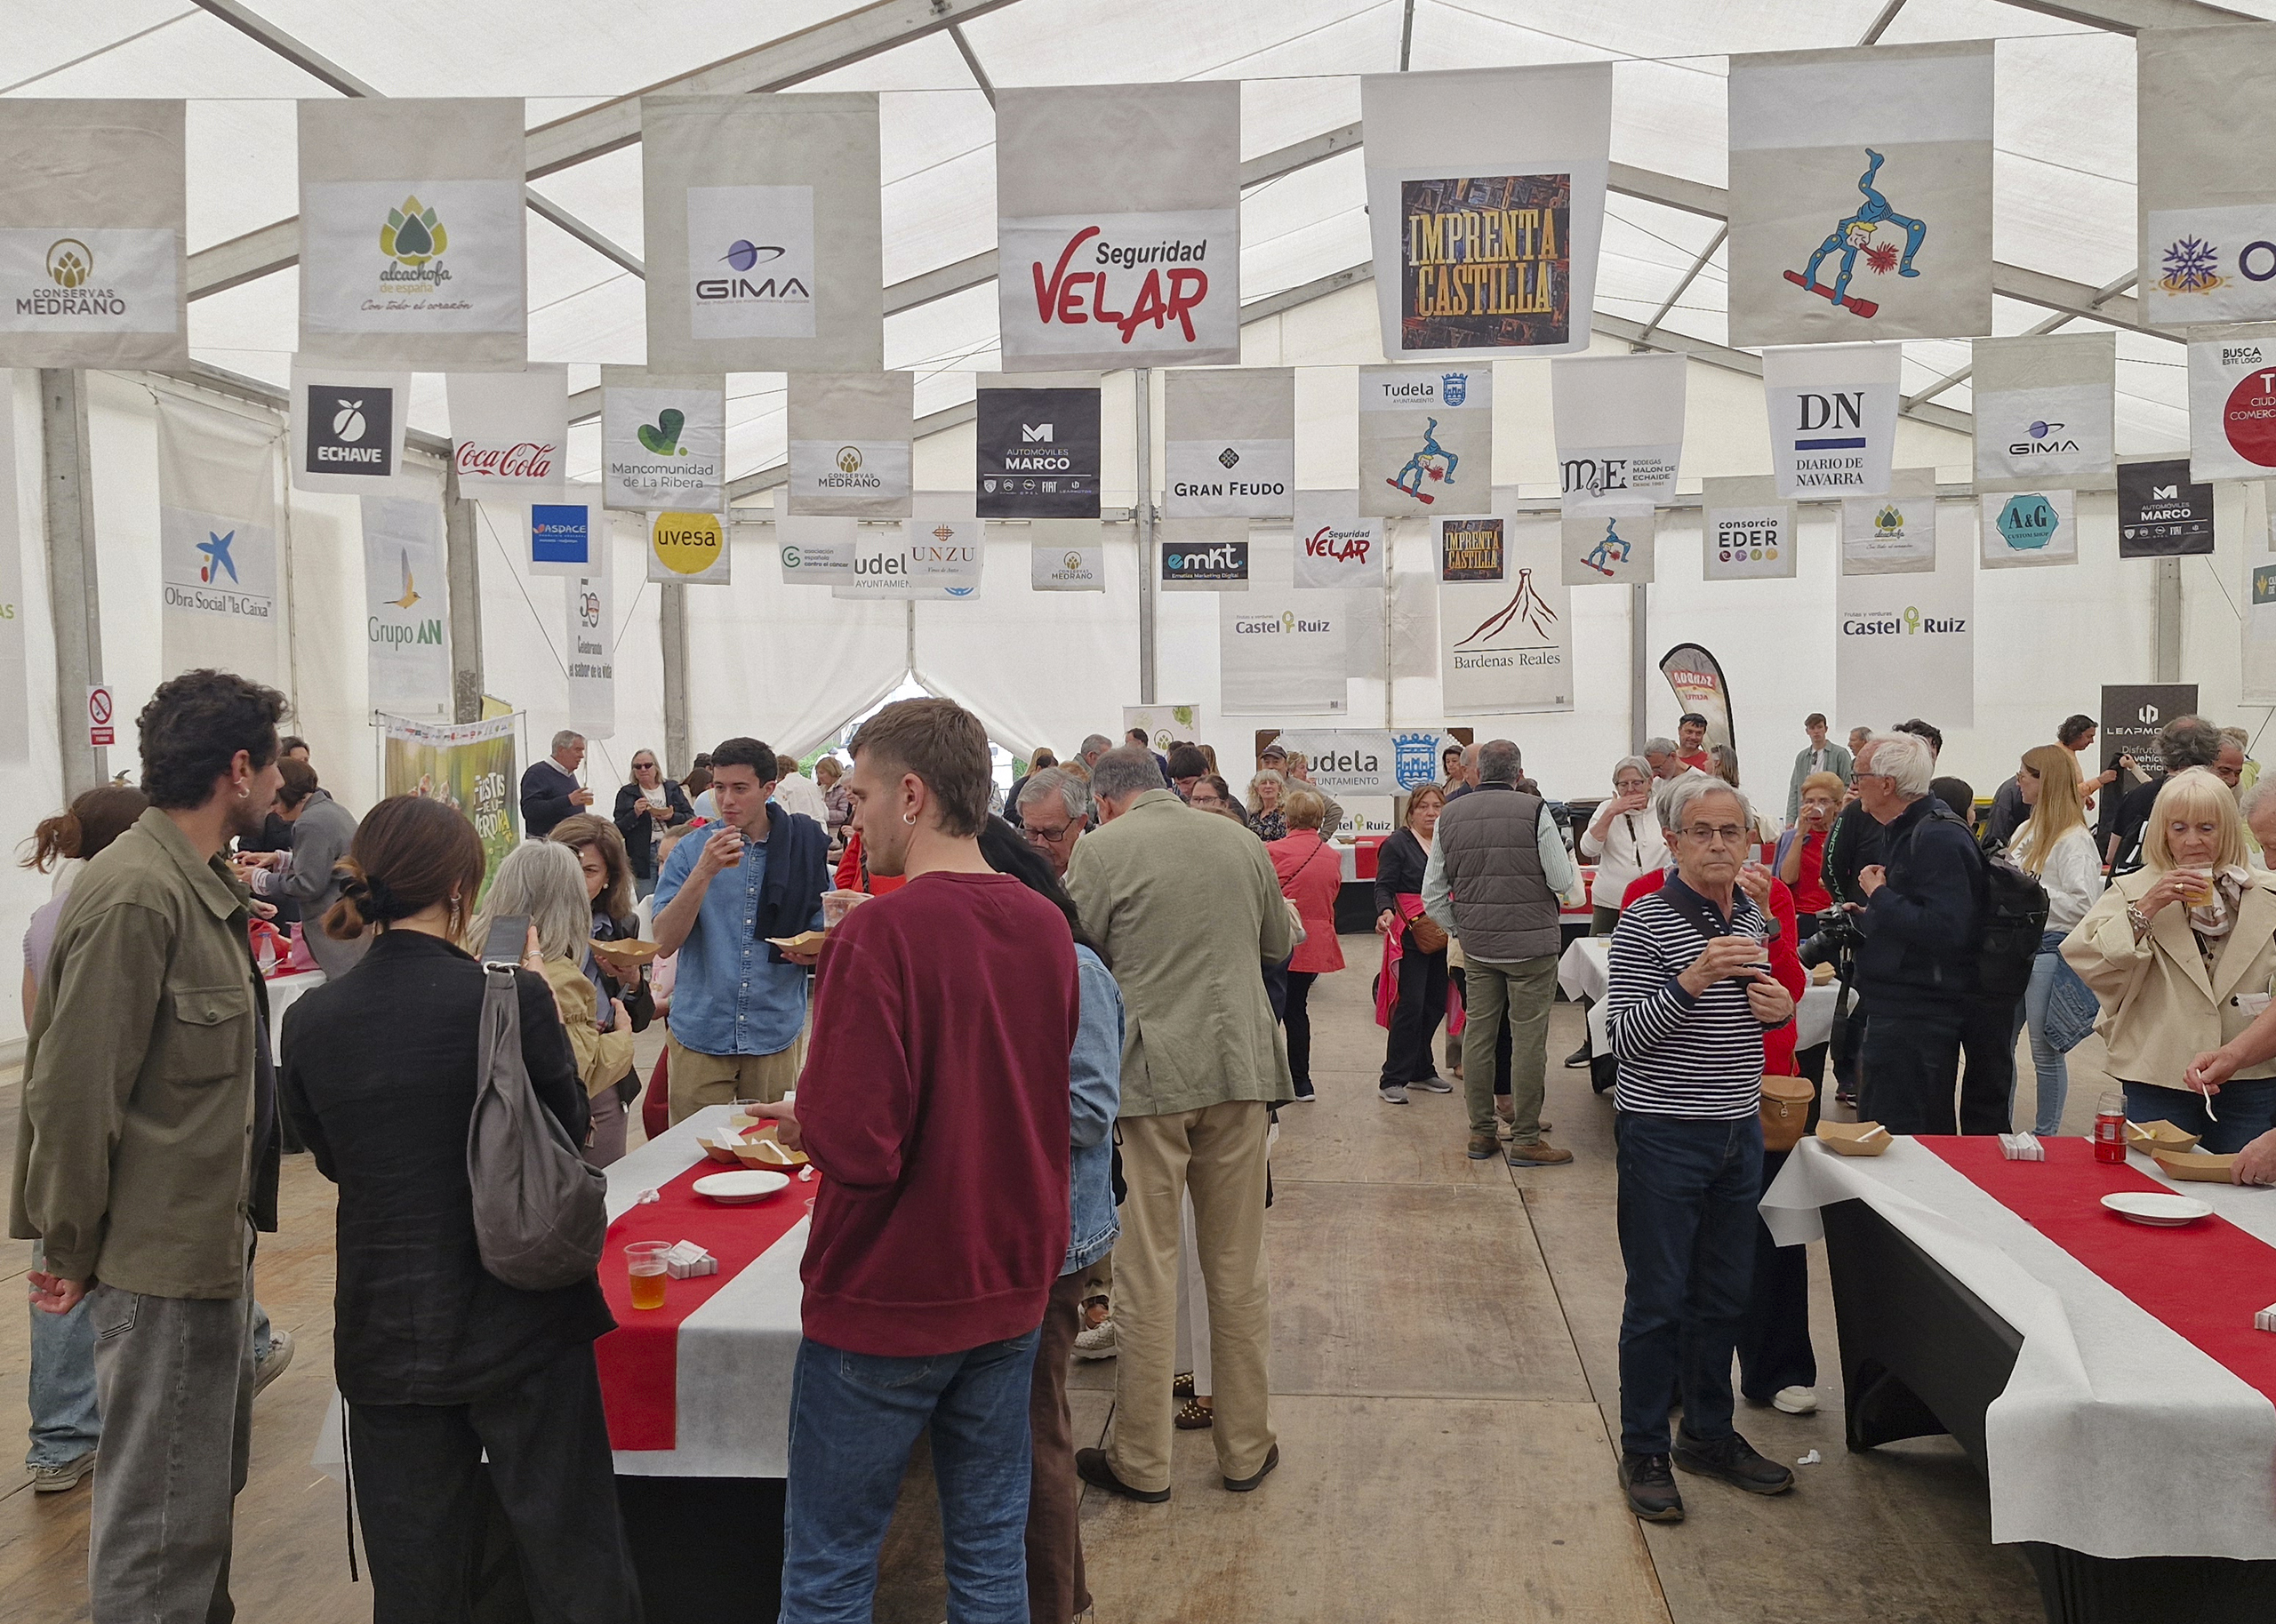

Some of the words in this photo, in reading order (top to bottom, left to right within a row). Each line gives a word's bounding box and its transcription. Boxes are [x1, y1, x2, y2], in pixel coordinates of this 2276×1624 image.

[1408, 208, 1559, 266] IMPRENTA
[1095, 239, 1207, 269] Seguridad
[380, 260, 453, 287] alcachofa
[380, 284, 394, 293] de
[396, 282, 434, 296] españa
[696, 277, 810, 300] GIMA
[1032, 225, 1208, 343] VELAR
[1418, 261, 1552, 317] CASTILLA
[32, 288, 115, 299] CONSERVAS
[16, 298, 126, 316] MEDRANO
[2223, 347, 2262, 359] BUSCA
[2223, 358, 2240, 366] ESTE
[2240, 356, 2263, 365] LOGO
[1382, 382, 1434, 397] Tudela
[1797, 392, 1865, 431] DN
[317, 445, 382, 463] ECHAVE
[1006, 447, 1069, 456] AUTOMÓVILES
[2009, 440, 2080, 455] GIMA
[612, 463, 714, 476] Mancomunidad
[1006, 457, 1071, 470] MARCO
[1632, 465, 1663, 474] MALON
[1796, 458, 1843, 471] DIARIO
[1845, 457, 1863, 469] DE
[622, 476, 639, 488] de
[643, 476, 657, 488] La
[661, 476, 703, 489] Ribera
[818, 477, 881, 488] MEDRANO
[1632, 473, 1671, 482] ECHAIDE
[1796, 471, 1864, 487] NAVARRA
[1042, 481, 1058, 493] FIAT
[1174, 482, 1222, 497] GRAN
[1229, 481, 1285, 496] FEUDO
[2142, 501, 2190, 511] AUTOMÓVILES
[2140, 508, 2192, 522] MARCO
[545, 524, 587, 534] ASPACE
[1719, 517, 1778, 530] consorcio
[2170, 525, 2182, 536] FIAT
[658, 531, 716, 547] uvesa
[1328, 531, 1370, 540] Seguridad
[1445, 531, 1499, 551] IMPRENTA
[1719, 530, 1778, 548] EDER
[1305, 525, 1370, 564] VELAR
[911, 546, 975, 562] UNZU
[1447, 549, 1498, 570] CASTILLA
[164, 587, 194, 608] Obra
[195, 591, 226, 612] Social
[367, 615, 414, 652] Grupo
[416, 618, 443, 645] AN
[1235, 620, 1280, 634] Castel
[1297, 620, 1331, 633] Ruiz
[1842, 618, 1901, 636] Castel
[1923, 617, 1966, 634] Ruiz
[1454, 654, 1514, 669] Bardenas
[1519, 651, 1561, 667] Reales
[574, 661, 590, 678] sabor
[602, 661, 613, 679] vida
[1315, 777, 1379, 785] UNTAMIENTO
[1338, 820, 1353, 831] tel
[1366, 820, 1391, 831] Ruiz
[1827, 816, 1843, 876] MADRID
